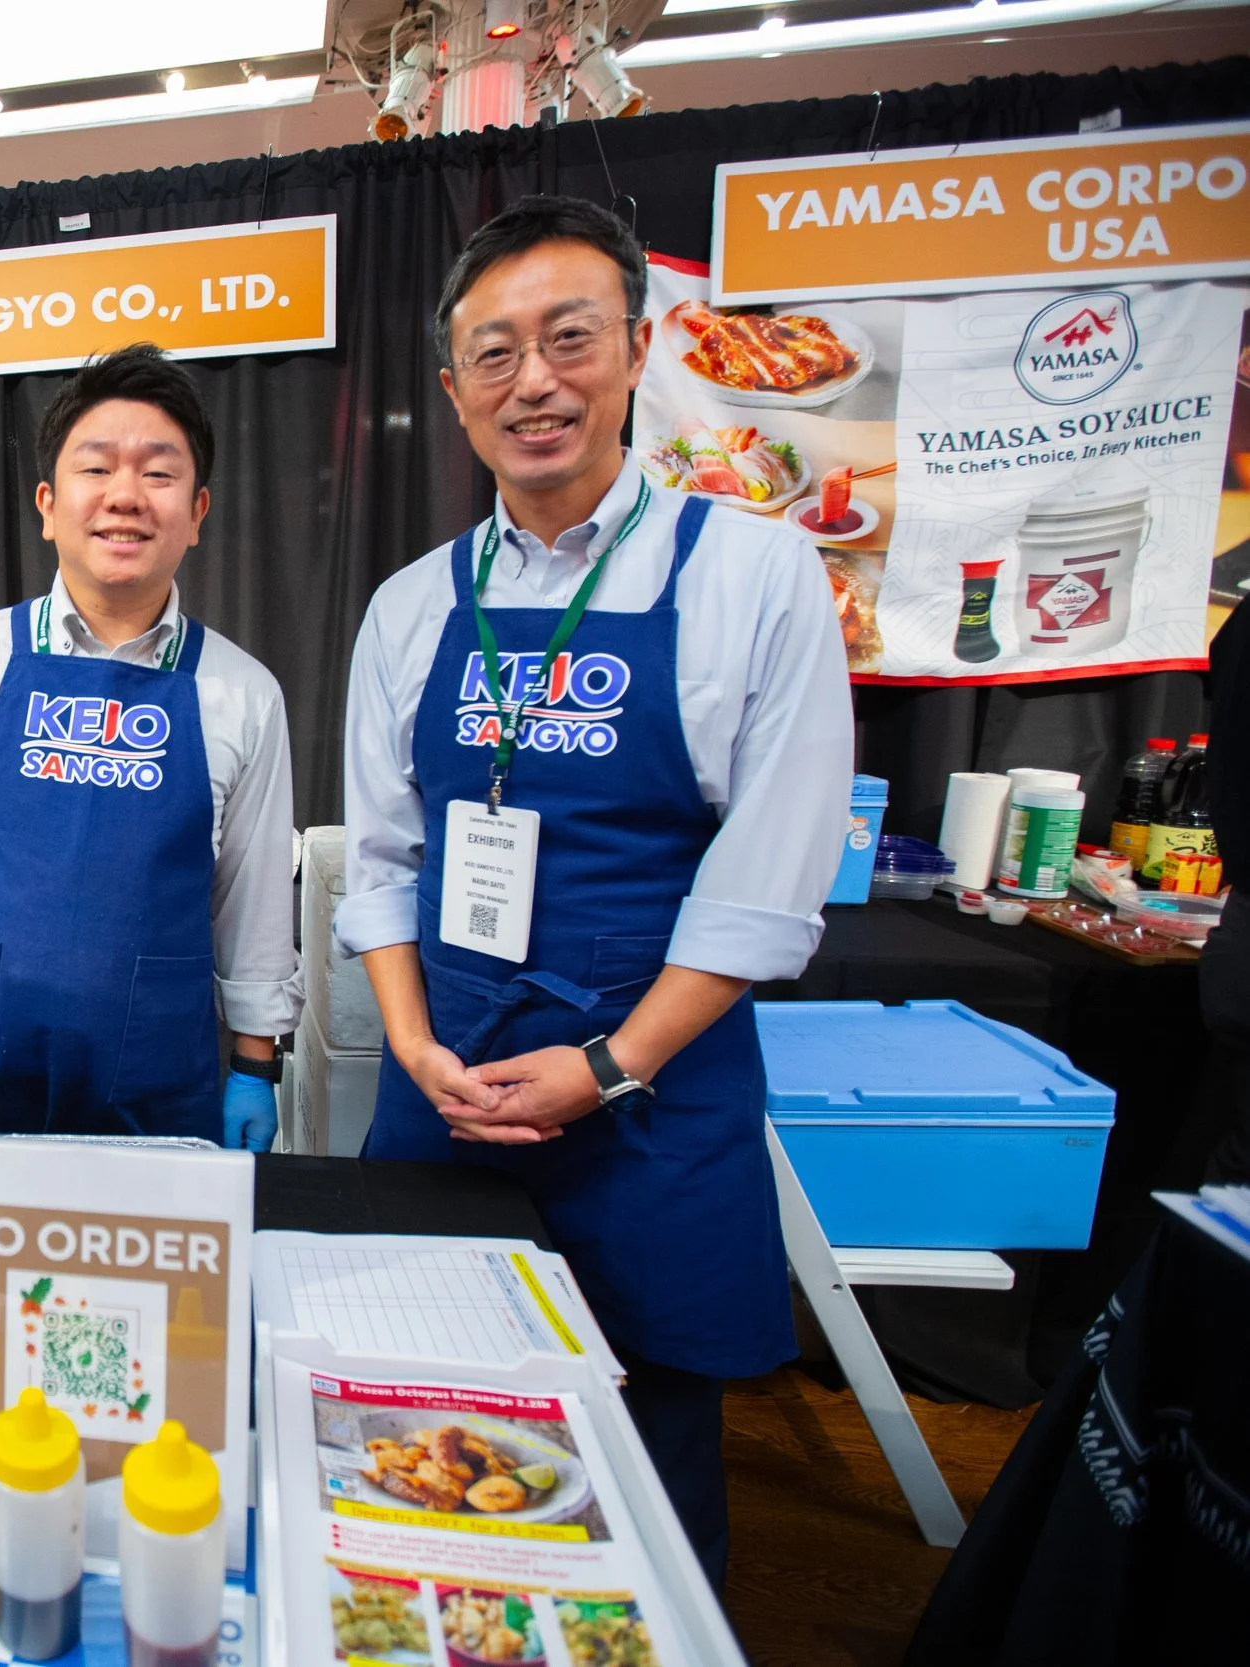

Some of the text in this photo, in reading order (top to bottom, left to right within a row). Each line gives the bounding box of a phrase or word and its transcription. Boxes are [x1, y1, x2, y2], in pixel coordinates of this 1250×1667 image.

[757, 157, 1247, 231] YAMASA CORPO
[1047, 215, 1170, 263] USA
[92, 283, 183, 325] CO.,
[200, 274, 291, 315] LTD.
[1030, 347, 1119, 372] YAMASA
[1052, 373, 1074, 382] SINCE
[917, 395, 1212, 453] YAMASA SOY SAUCE
[925, 427, 1202, 475] The Chef's Choice, In Every Kitchen
[459, 651, 631, 709] KEIO
[24, 691, 171, 750] KEIO
[20, 748, 163, 791] SANGYO
[467, 833, 515, 850] EXHIBITOR
[37, 1222, 220, 1274] ORDER
[349, 1383, 393, 1397] Frozen
[395, 1387, 450, 1400] Octopus
